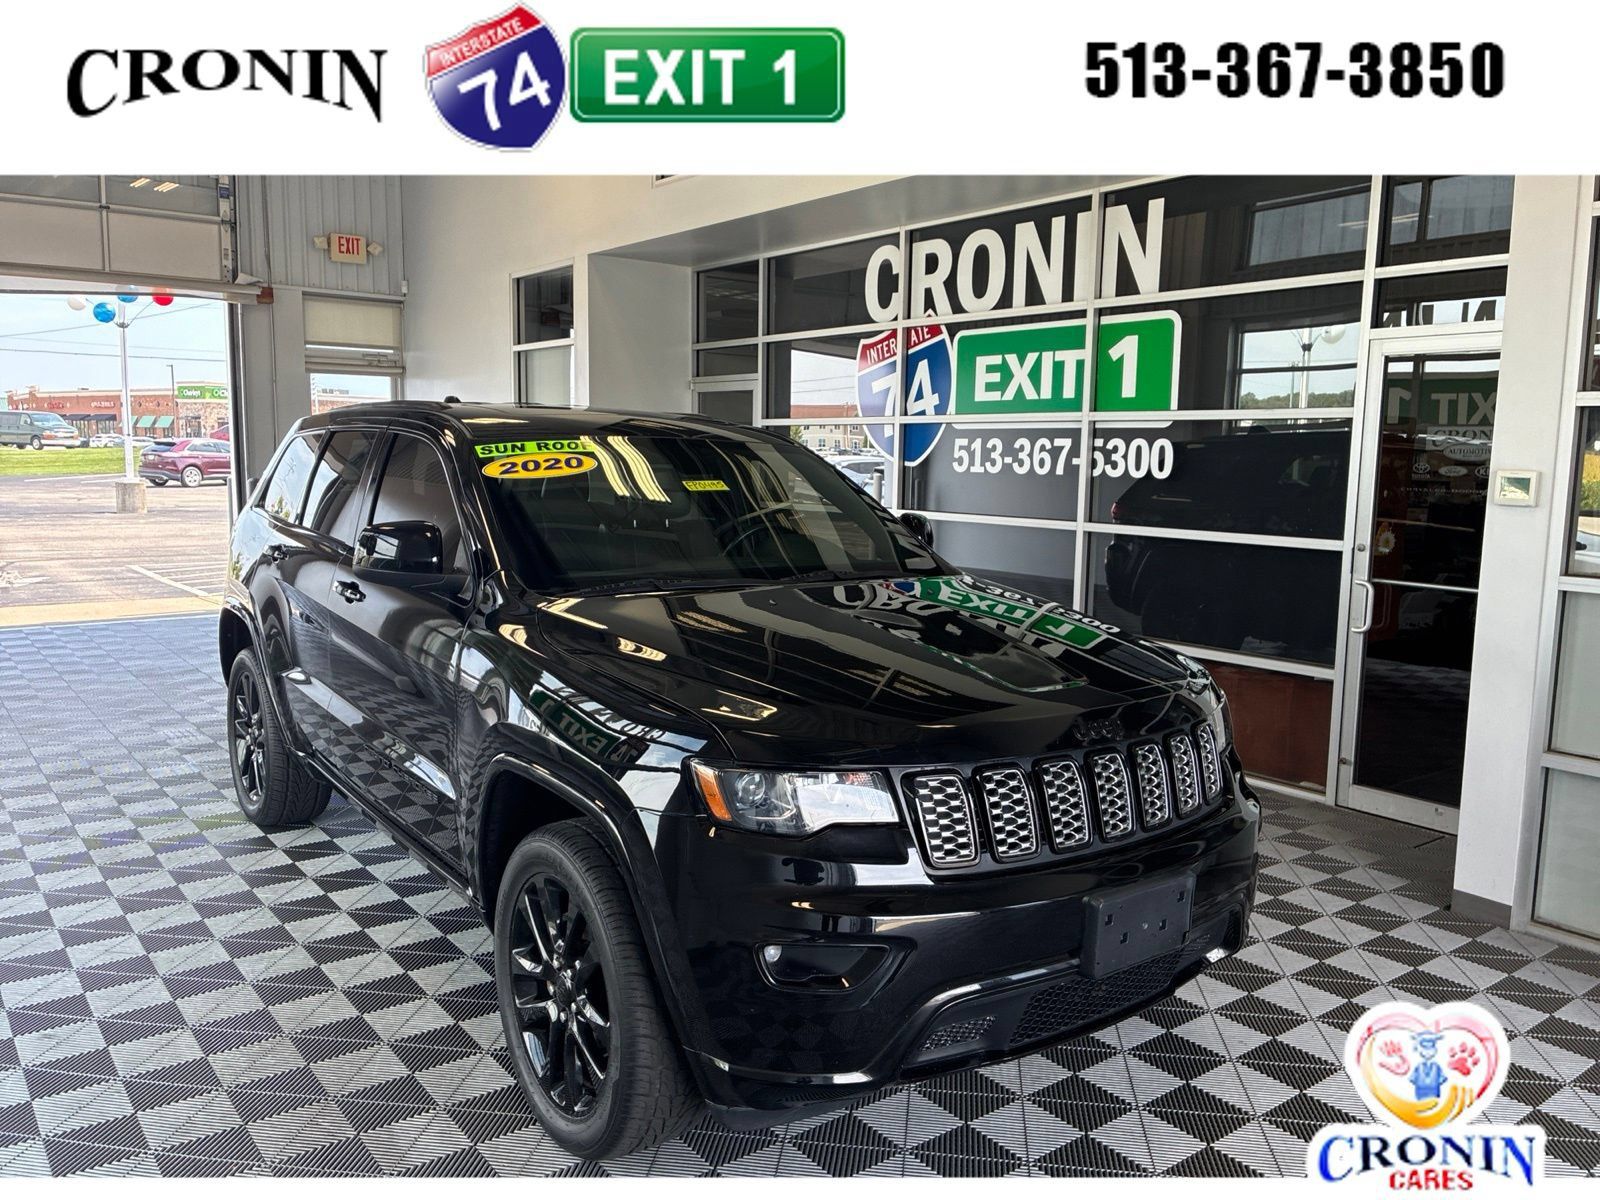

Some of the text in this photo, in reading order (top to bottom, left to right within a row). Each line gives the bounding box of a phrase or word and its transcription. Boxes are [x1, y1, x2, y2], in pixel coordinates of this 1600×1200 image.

[337, 235, 361, 256] EXIT
[864, 197, 1166, 324] CRONIN
[865, 325, 931, 366] INTERATE
[974, 334, 1140, 402] EXIT 1
[871, 358, 941, 439] 74
[478, 440, 594, 456] SUN ROOF
[498, 455, 585, 475] 2020
[952, 437, 1174, 480] 513-367-5300
